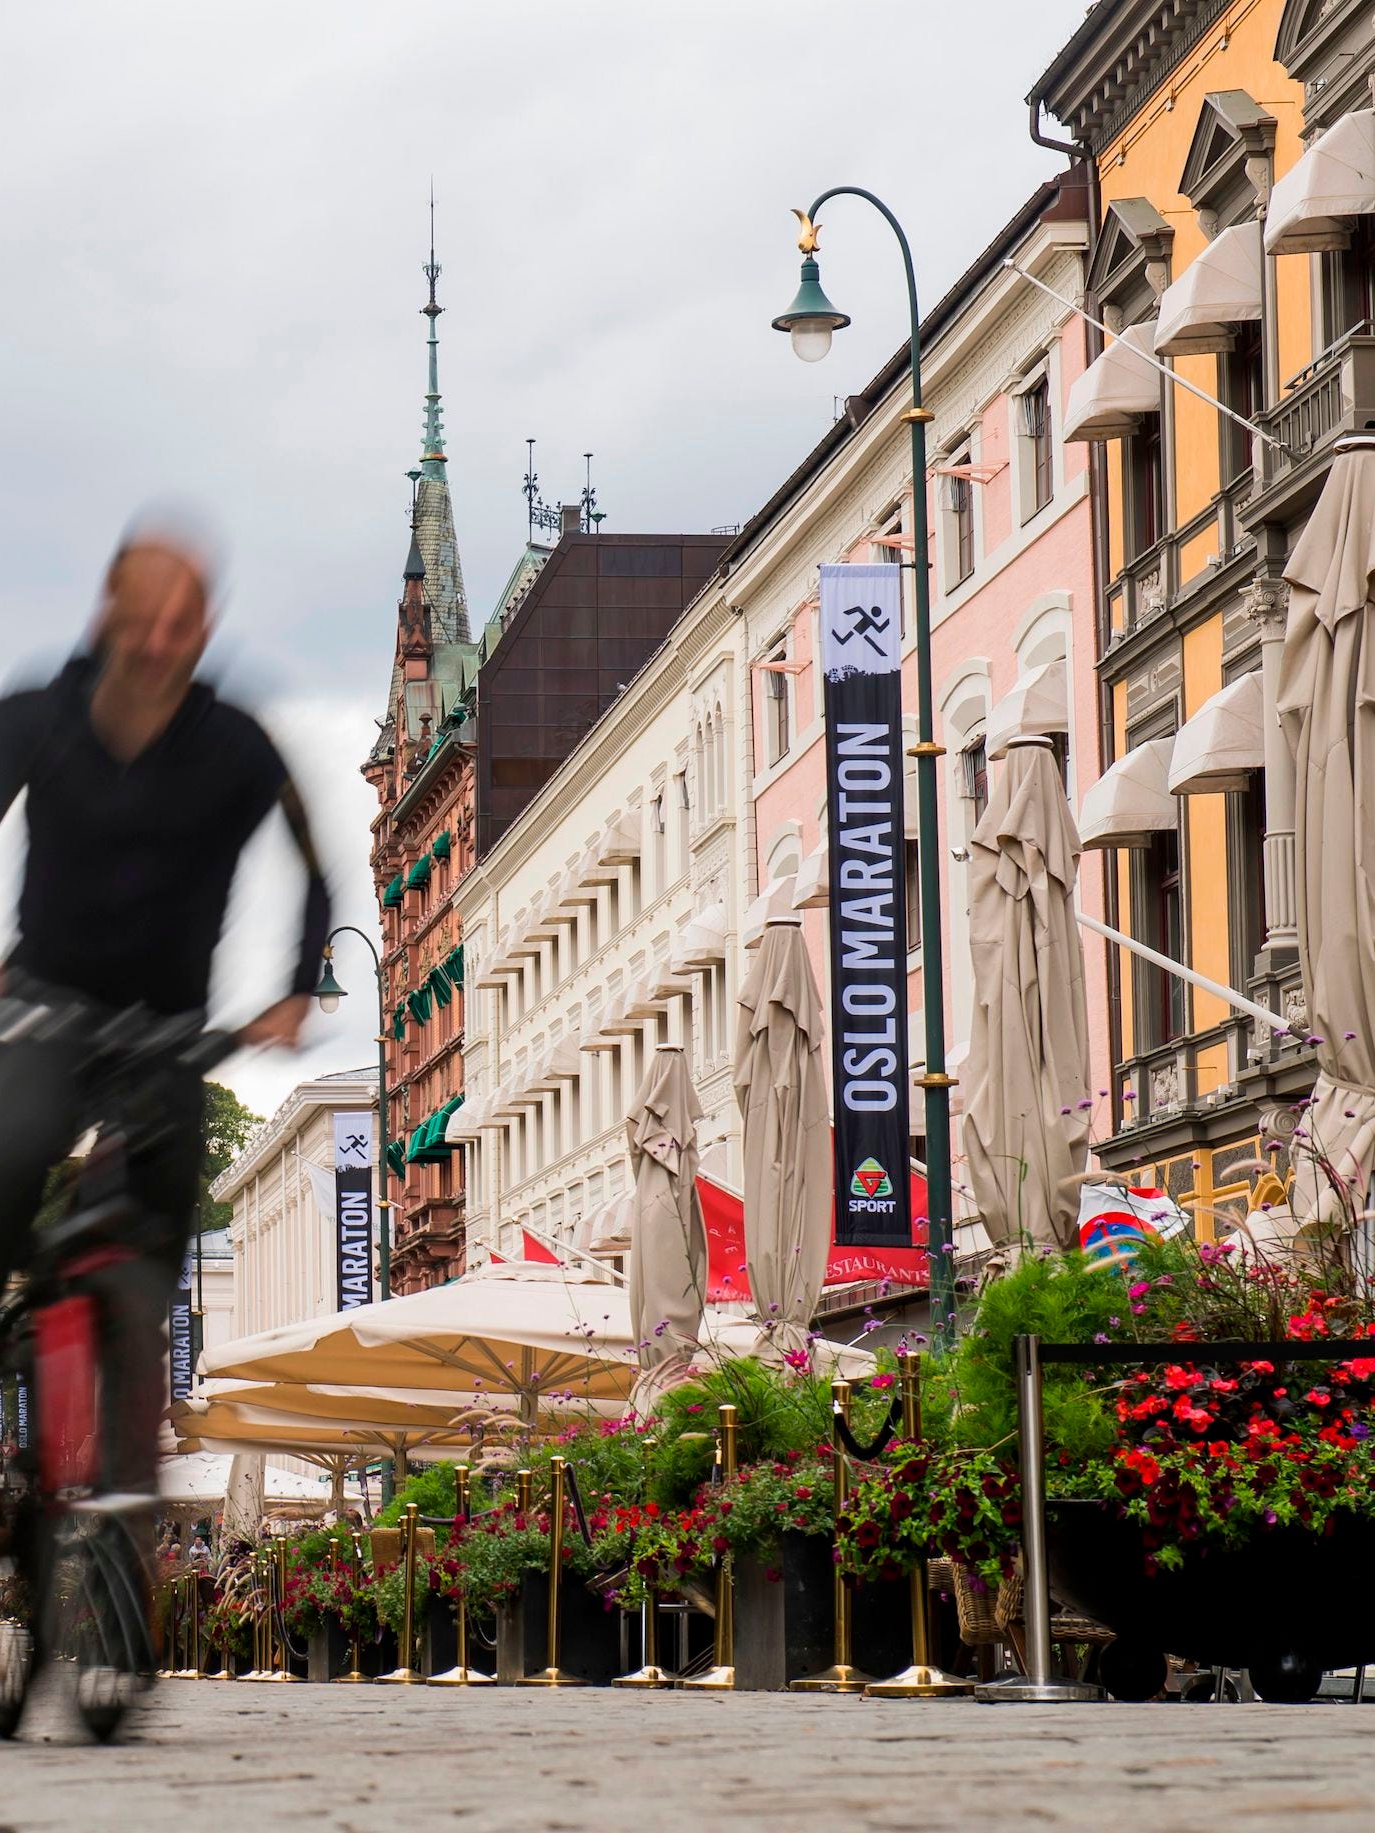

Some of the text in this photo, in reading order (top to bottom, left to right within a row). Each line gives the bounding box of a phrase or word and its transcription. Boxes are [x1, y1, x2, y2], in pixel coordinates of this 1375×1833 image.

[836, 722, 899, 1113] OSLO MARATON
[849, 1200, 896, 1213] SPORT
[341, 1191, 368, 1312] MARATON
[824, 1256, 929, 1281] ESTAURANTS
[172, 1305, 191, 1384] MARATON
[18, 1387, 28, 1449] OSLO MARATON
